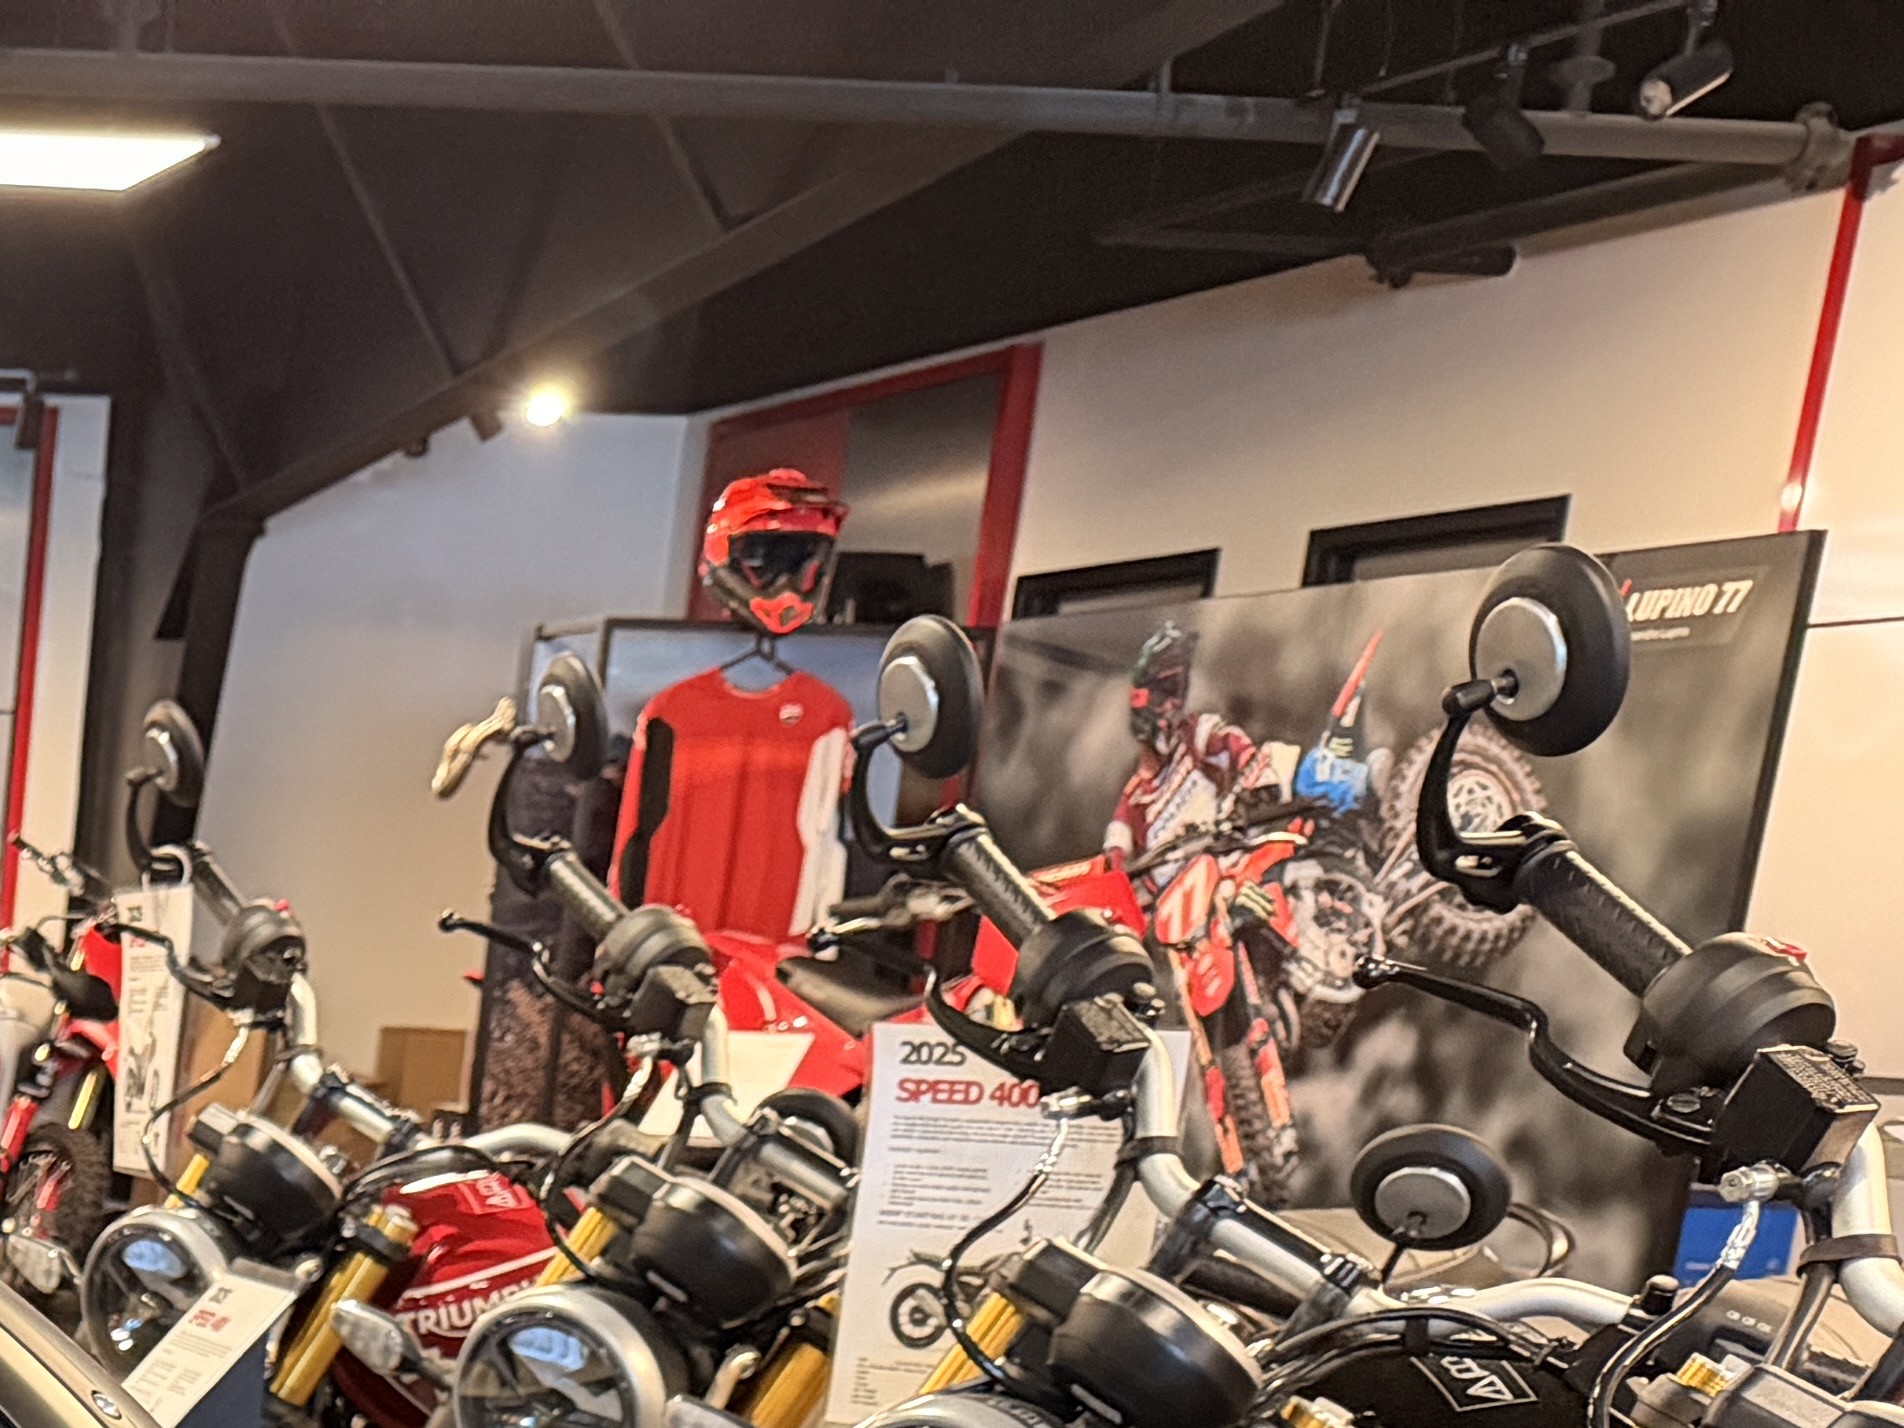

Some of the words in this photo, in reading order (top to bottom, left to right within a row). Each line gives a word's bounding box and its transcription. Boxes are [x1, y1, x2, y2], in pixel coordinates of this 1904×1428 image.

[1713, 579, 1753, 614] 77
[900, 1041, 967, 1066] 2025
[895, 1078, 984, 1106] SPEED
[989, 1080, 1040, 1108] 400
[394, 1279, 530, 1338] TRIUMP
